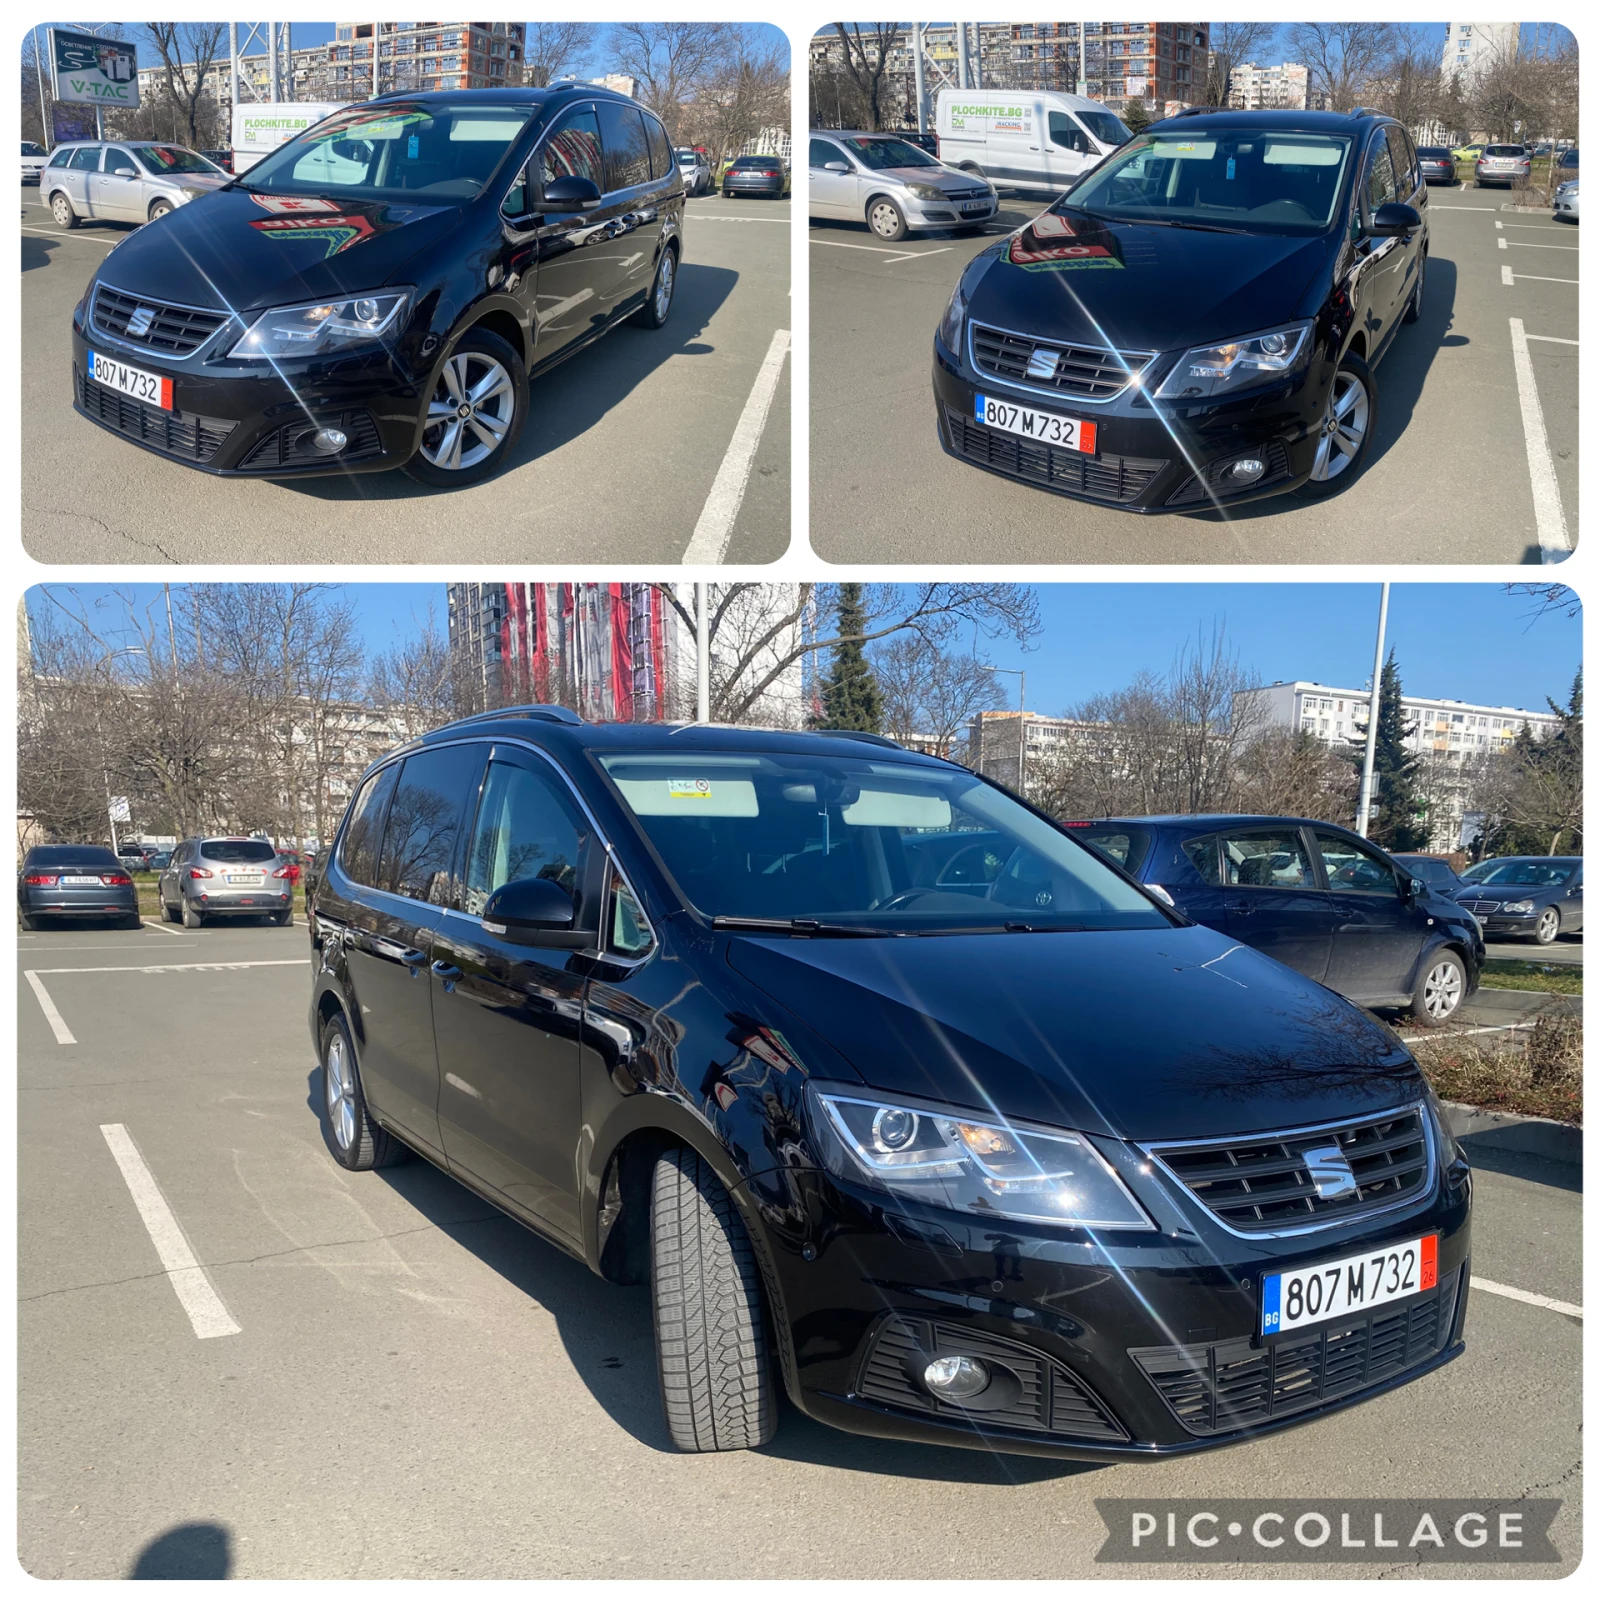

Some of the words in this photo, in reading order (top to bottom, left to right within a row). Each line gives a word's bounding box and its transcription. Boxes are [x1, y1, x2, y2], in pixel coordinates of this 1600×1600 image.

[60, 41, 93, 51] ОСВЕТЛЕНИЕ
[70, 79, 129, 99] V-TAC
[952, 105, 1023, 117] PLOCHKITE.BG
[244, 118, 308, 129] PLOCHKITE.BG
[95, 357, 117, 384] 807
[119, 366, 128, 390] M
[130, 370, 157, 402] 732
[976, 411, 984, 419] BG
[986, 401, 1019, 428] 807
[1022, 411, 1034, 435] M
[1038, 415, 1075, 446] 732
[1264, 1311, 1279, 1327] BG
[1286, 1267, 1342, 1321] 807
[1347, 1261, 1364, 1306] M
[1371, 1249, 1415, 1300] 732
[1423, 1271, 1434, 1285] 26
